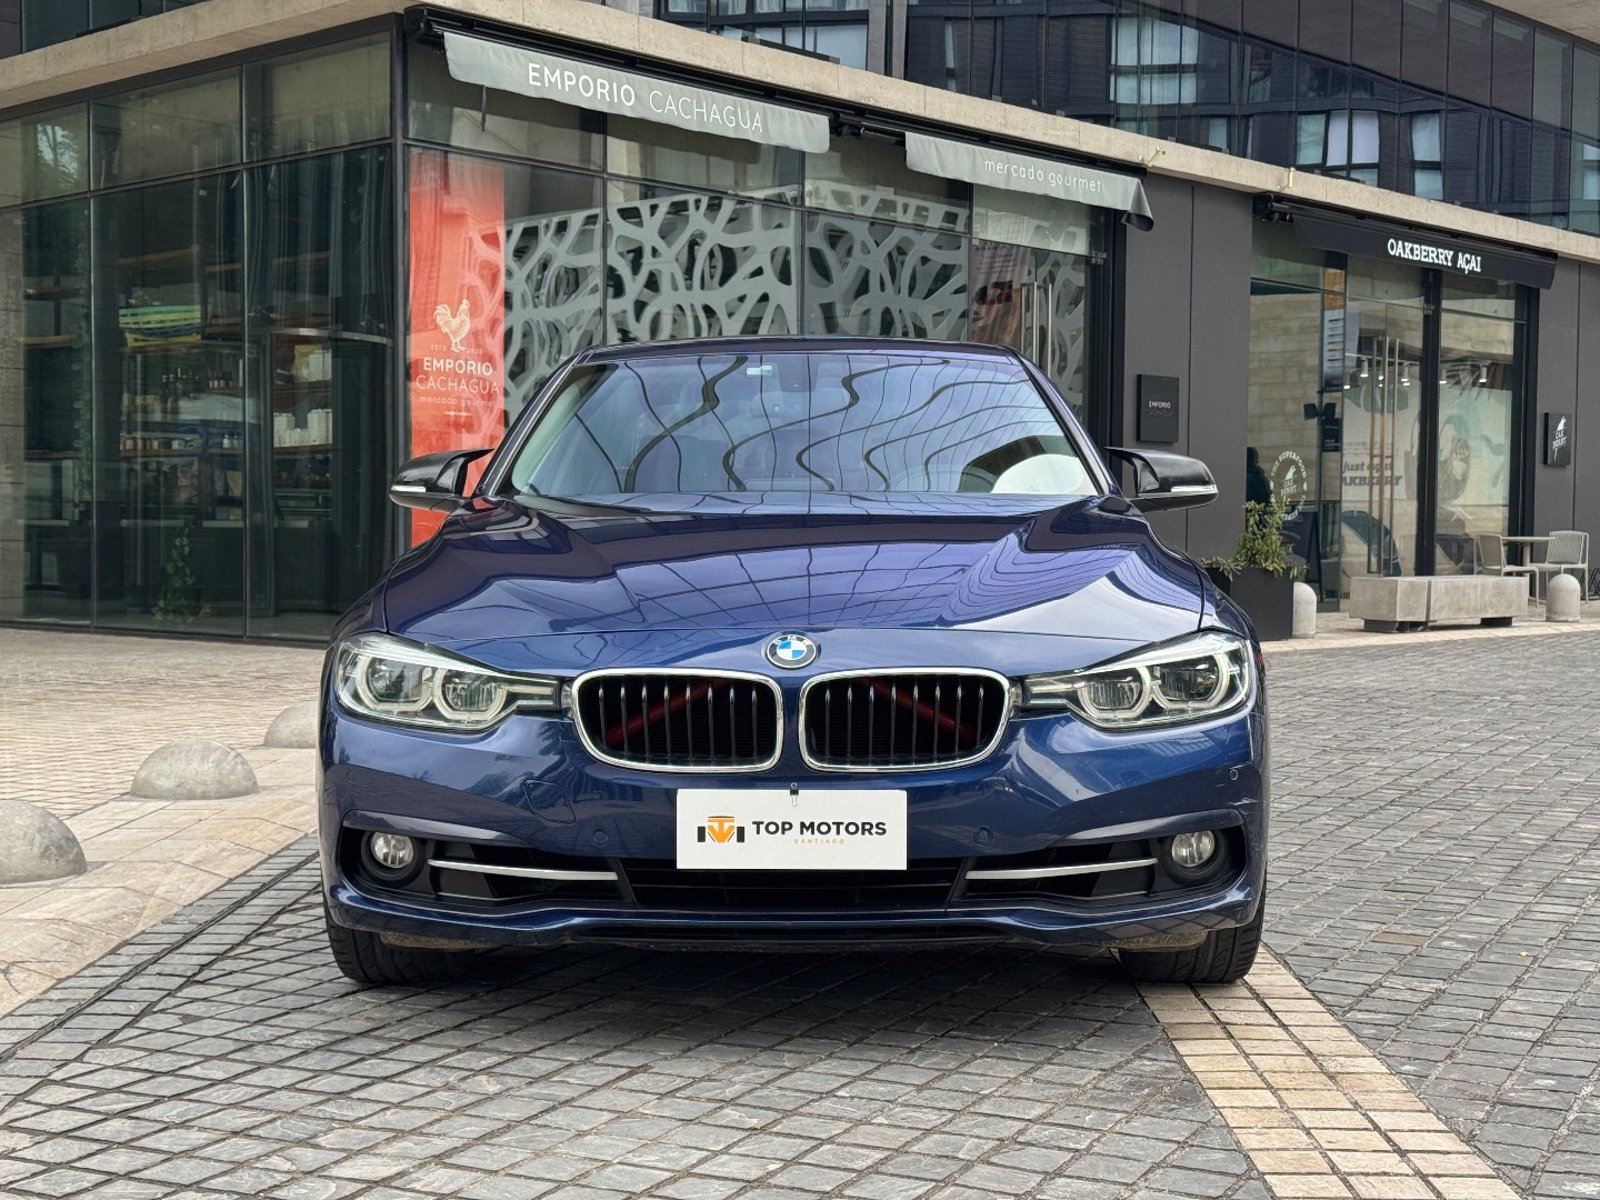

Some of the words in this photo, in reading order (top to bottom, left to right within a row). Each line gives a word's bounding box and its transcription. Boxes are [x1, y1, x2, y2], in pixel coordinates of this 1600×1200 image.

[528, 62, 635, 107] EMPORIO
[649, 90, 763, 133] CACHAGUA
[985, 160, 1044, 181] mercado
[1048, 172, 1101, 193] gourmet
[1387, 238, 1454, 267] OAKBERRY
[423, 357, 493, 376] EMPORIO
[416, 375, 500, 394] CACHAGUA
[419, 395, 458, 405] mercado
[461, 398, 497, 409] gourmet
[752, 820, 793, 835] TOP
[800, 821, 887, 836] MOTORS
